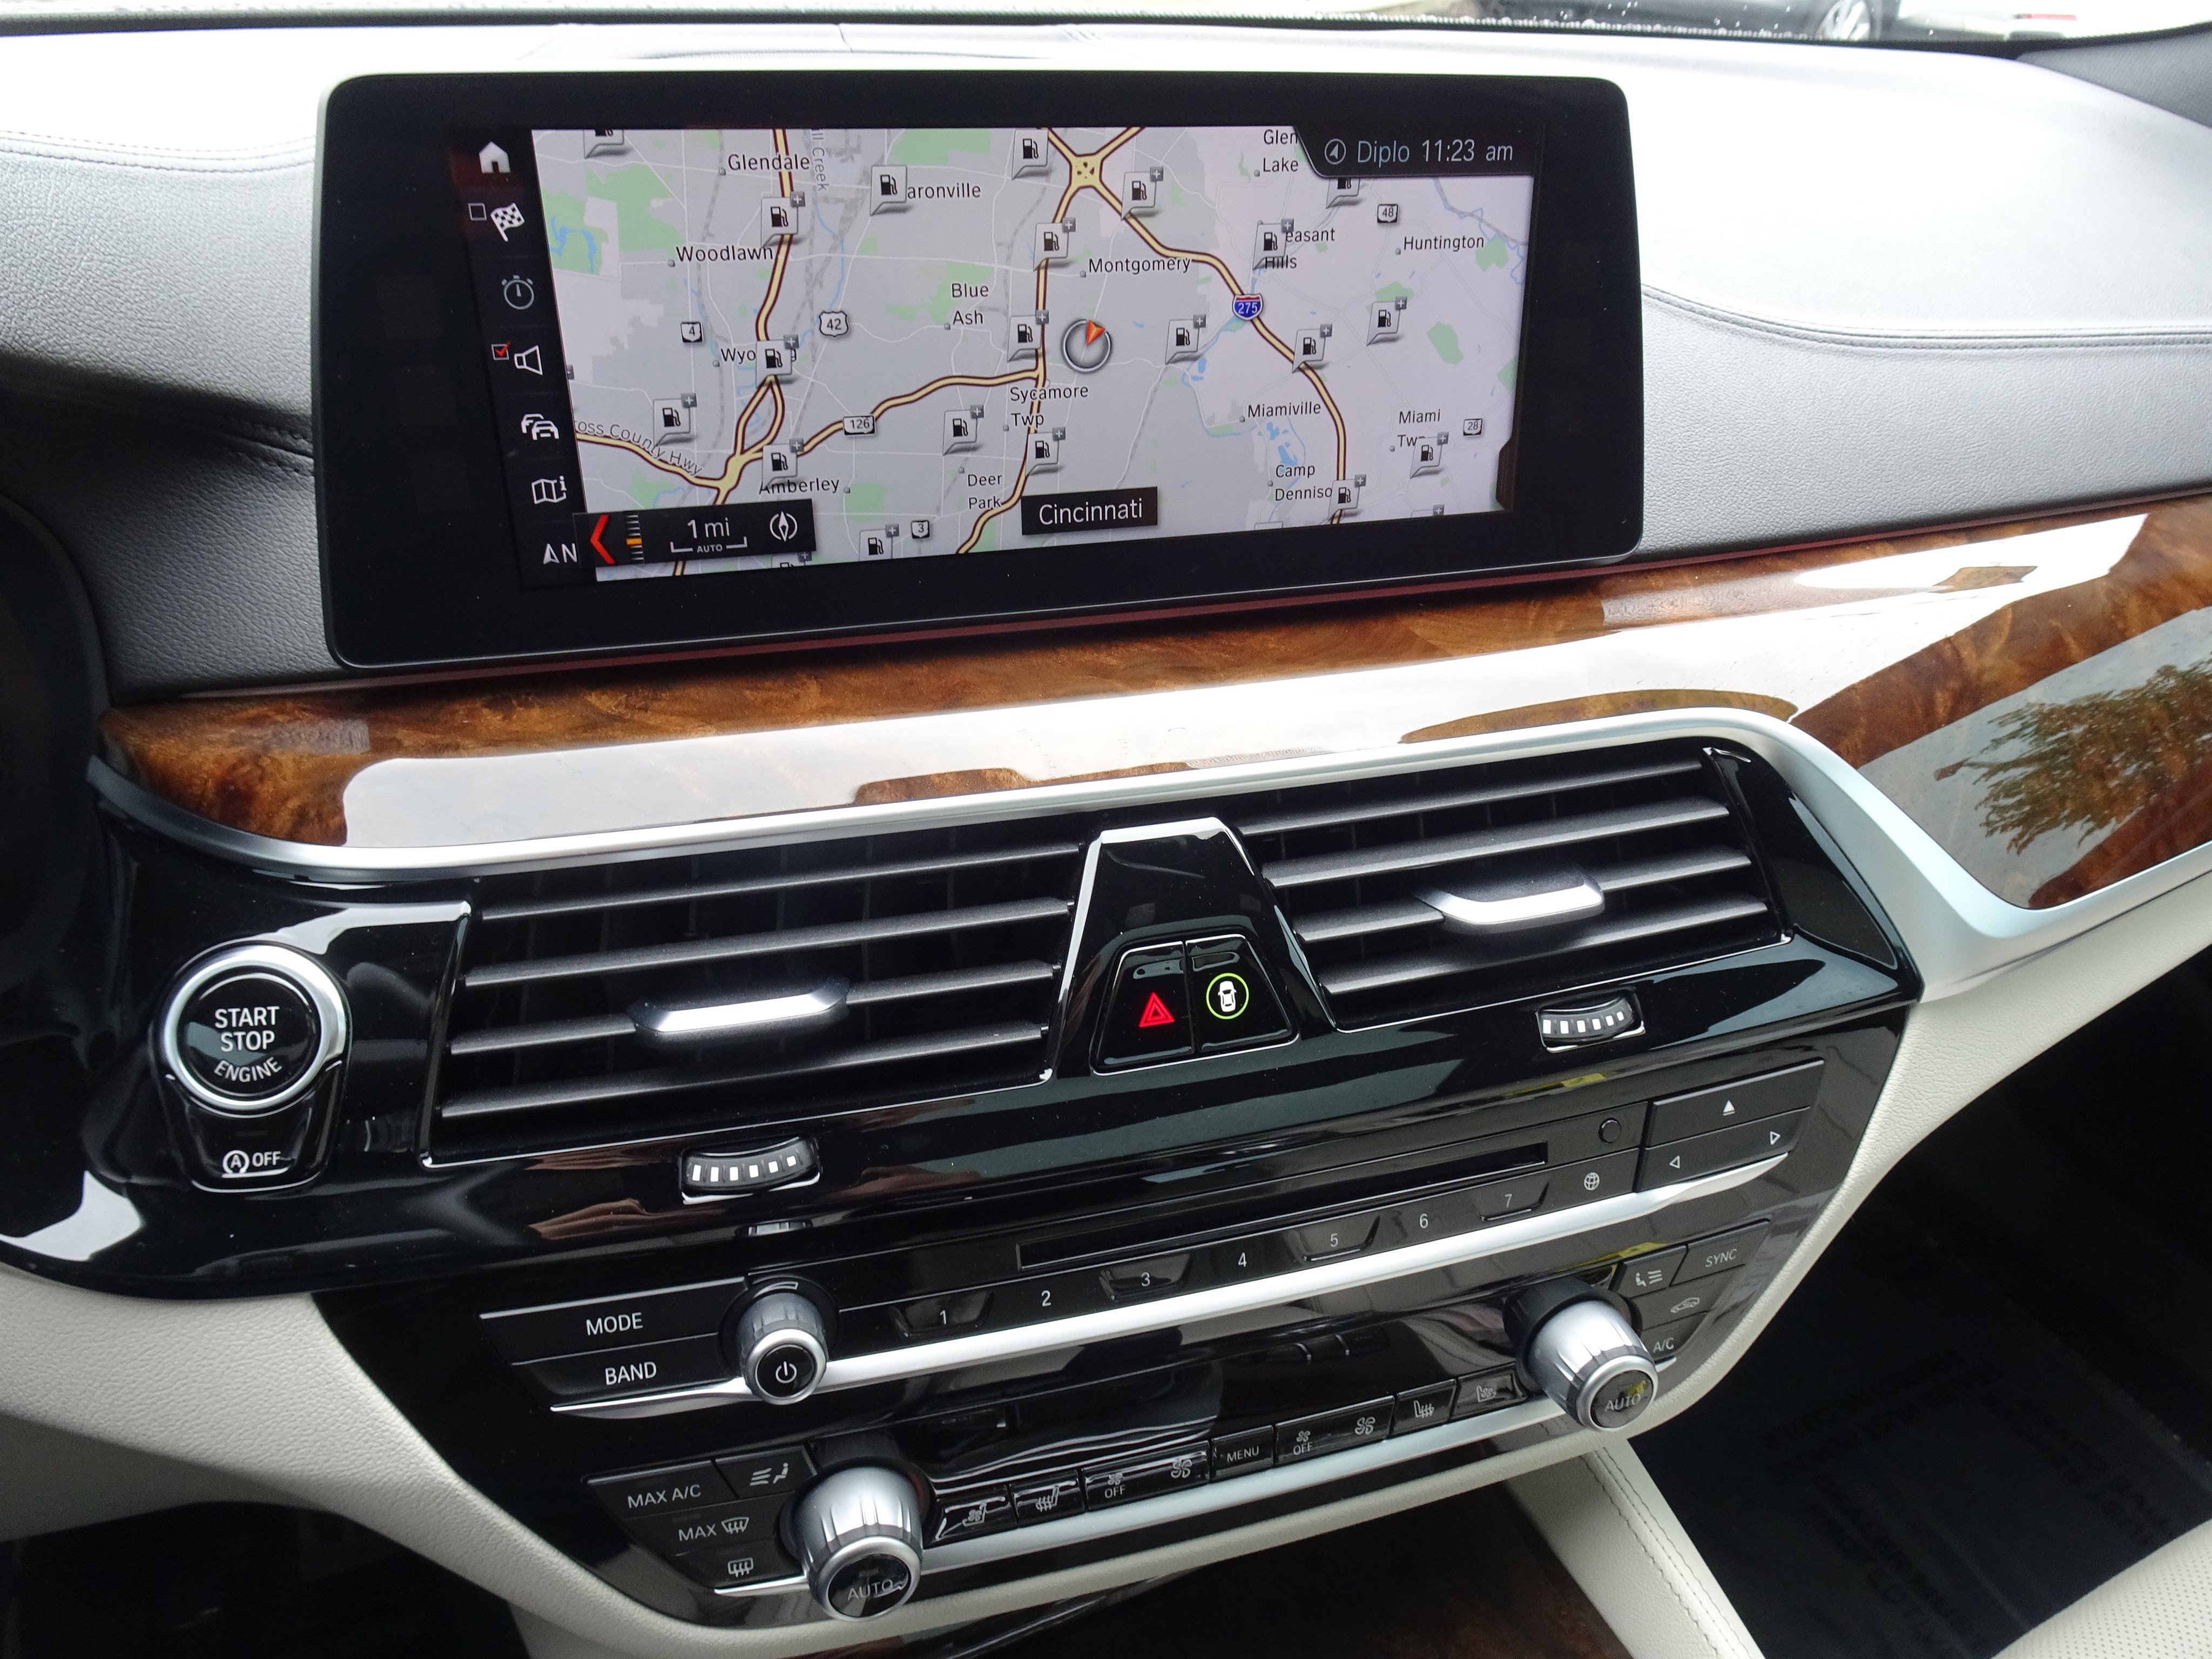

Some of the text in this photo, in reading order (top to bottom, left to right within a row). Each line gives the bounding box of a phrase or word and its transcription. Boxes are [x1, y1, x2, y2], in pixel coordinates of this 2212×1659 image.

[1264, 129, 1298, 145] Glen
[1357, 138, 1513, 167] Diplo 11:23 am
[728, 154, 810, 172] Glendale
[812, 147, 829, 191] Creek
[1263, 157, 1298, 172] Lake
[907, 183, 981, 199] aronville
[1382, 207, 1394, 218] 48
[1285, 227, 1336, 242] easant
[1404, 235, 1485, 253] Huntington
[676, 246, 773, 263] Woodlawn
[1089, 257, 1191, 274] Montgomery
[952, 282, 989, 298] Blue
[1237, 301, 1258, 315] 275
[827, 318, 841, 331] 42
[953, 311, 983, 325] Ash
[689, 325, 696, 336] 4
[1010, 384, 1089, 403] Sycamore
[1247, 401, 1321, 419] Miamiville
[1399, 409, 1441, 424] Miami
[849, 417, 871, 430] 126
[1011, 413, 1044, 428] Twp
[1467, 421, 1479, 431] 28
[575, 420, 604, 435] oss
[670, 450, 703, 476] Hwy
[1398, 435, 1425, 448] Tw
[1276, 464, 1316, 479] Camp
[759, 477, 840, 496] Amberley
[967, 474, 1003, 487] Deer
[1274, 485, 1332, 502] Denniso
[969, 495, 1002, 510] Park
[1038, 498, 1143, 527] Cincinnati
[918, 523, 925, 534] 3
[697, 543, 723, 554] AUTO
[214, 1006, 280, 1028] START
[220, 1030, 275, 1052] STOP
[214, 1056, 282, 1083] ENGINE
[252, 1151, 281, 1167] OFF
[940, 1193, 1513, 1325] 1 2 3 4 5 6 7
[1705, 1249, 1737, 1268] SYNC
[585, 1312, 643, 1336] MODE
[1653, 1337, 1674, 1353] A/C
[604, 1361, 657, 1385] BAND
[1604, 1393, 1641, 1412] AUTO
[1226, 1445, 1259, 1463] MENU
[1293, 1442, 1313, 1455] OFF
[628, 1484, 701, 1509] MAX A/C
[1104, 1485, 1125, 1499] OFF
[678, 1524, 717, 1542] MAX
[848, 1579, 893, 1601] AUTO
